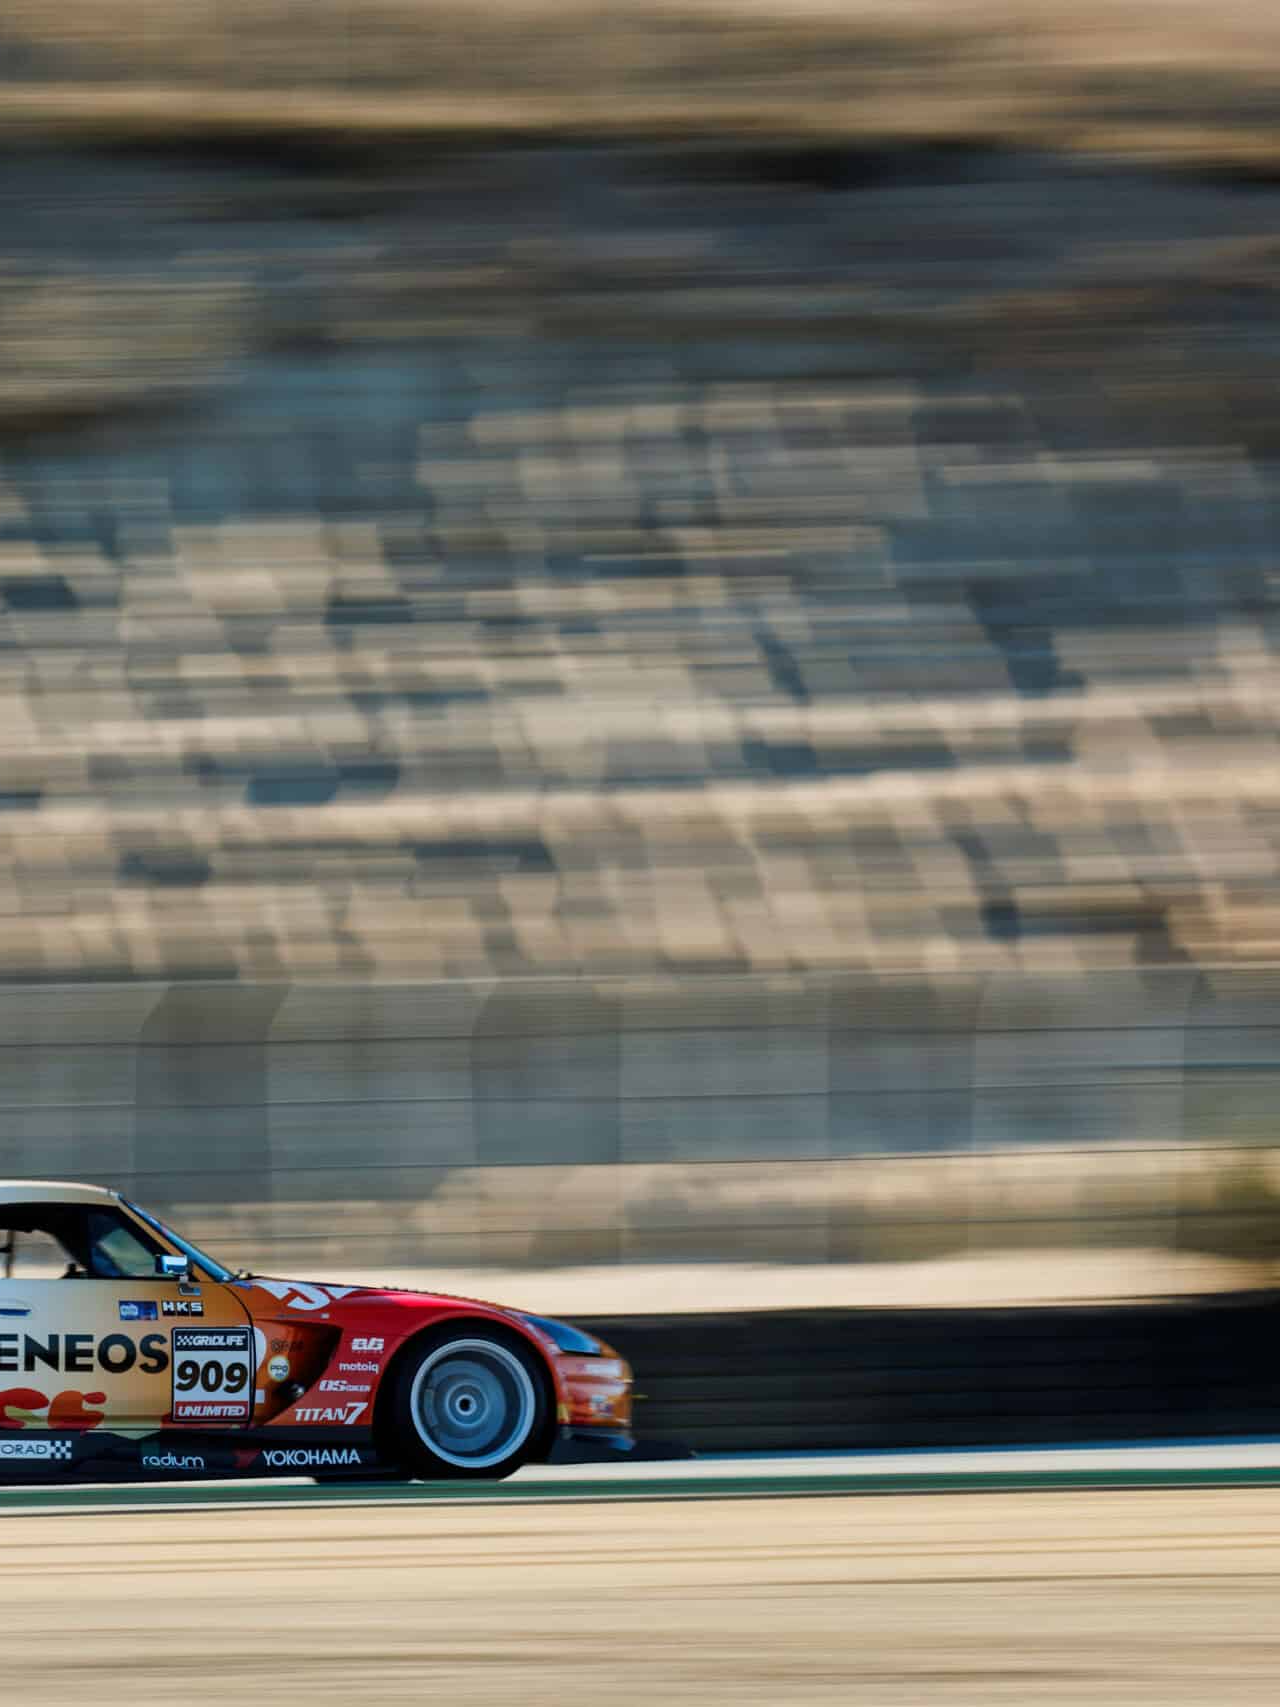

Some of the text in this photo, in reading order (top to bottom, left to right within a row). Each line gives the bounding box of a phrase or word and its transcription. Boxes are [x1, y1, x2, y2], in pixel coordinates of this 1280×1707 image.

[162, 1301, 203, 1313] HKS
[192, 1335, 247, 1346] GRIDLIFE
[176, 1360, 248, 1394] 909
[177, 1405, 246, 1417] UNLIMITED
[142, 1451, 205, 1469] radium
[262, 1448, 362, 1467] YOKOHAMA
